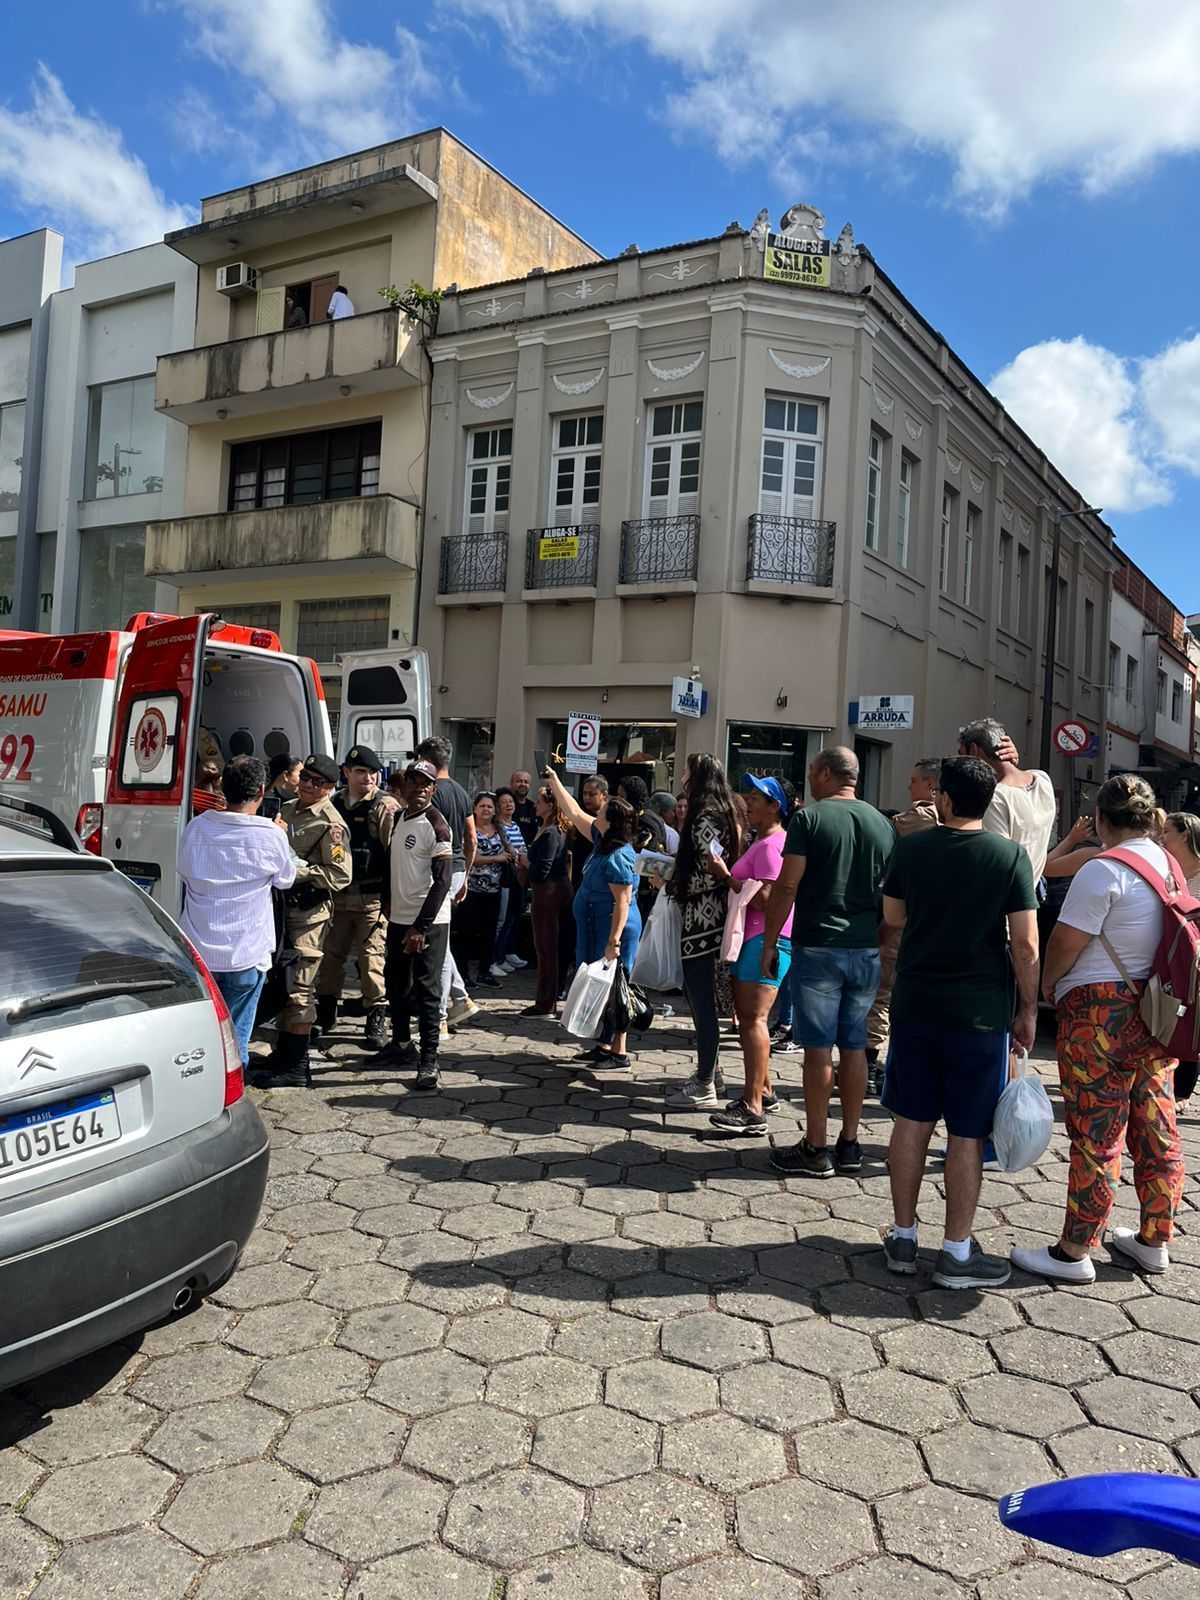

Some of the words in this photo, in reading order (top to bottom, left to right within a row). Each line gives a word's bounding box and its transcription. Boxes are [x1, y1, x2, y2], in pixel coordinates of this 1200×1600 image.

[773, 233, 824, 255] ALUGA-SE
[772, 250, 822, 275] SALAS
[543, 526, 577, 538] ALUGA-SE
[0, 693, 48, 717] SAMU
[863, 712, 906, 722] ARRUDA
[578, 725, 589, 746] E
[173, 1047, 206, 1066] C3
[26, 1111, 53, 1124] BRASIL
[1006, 1489, 1025, 1515] AHA
